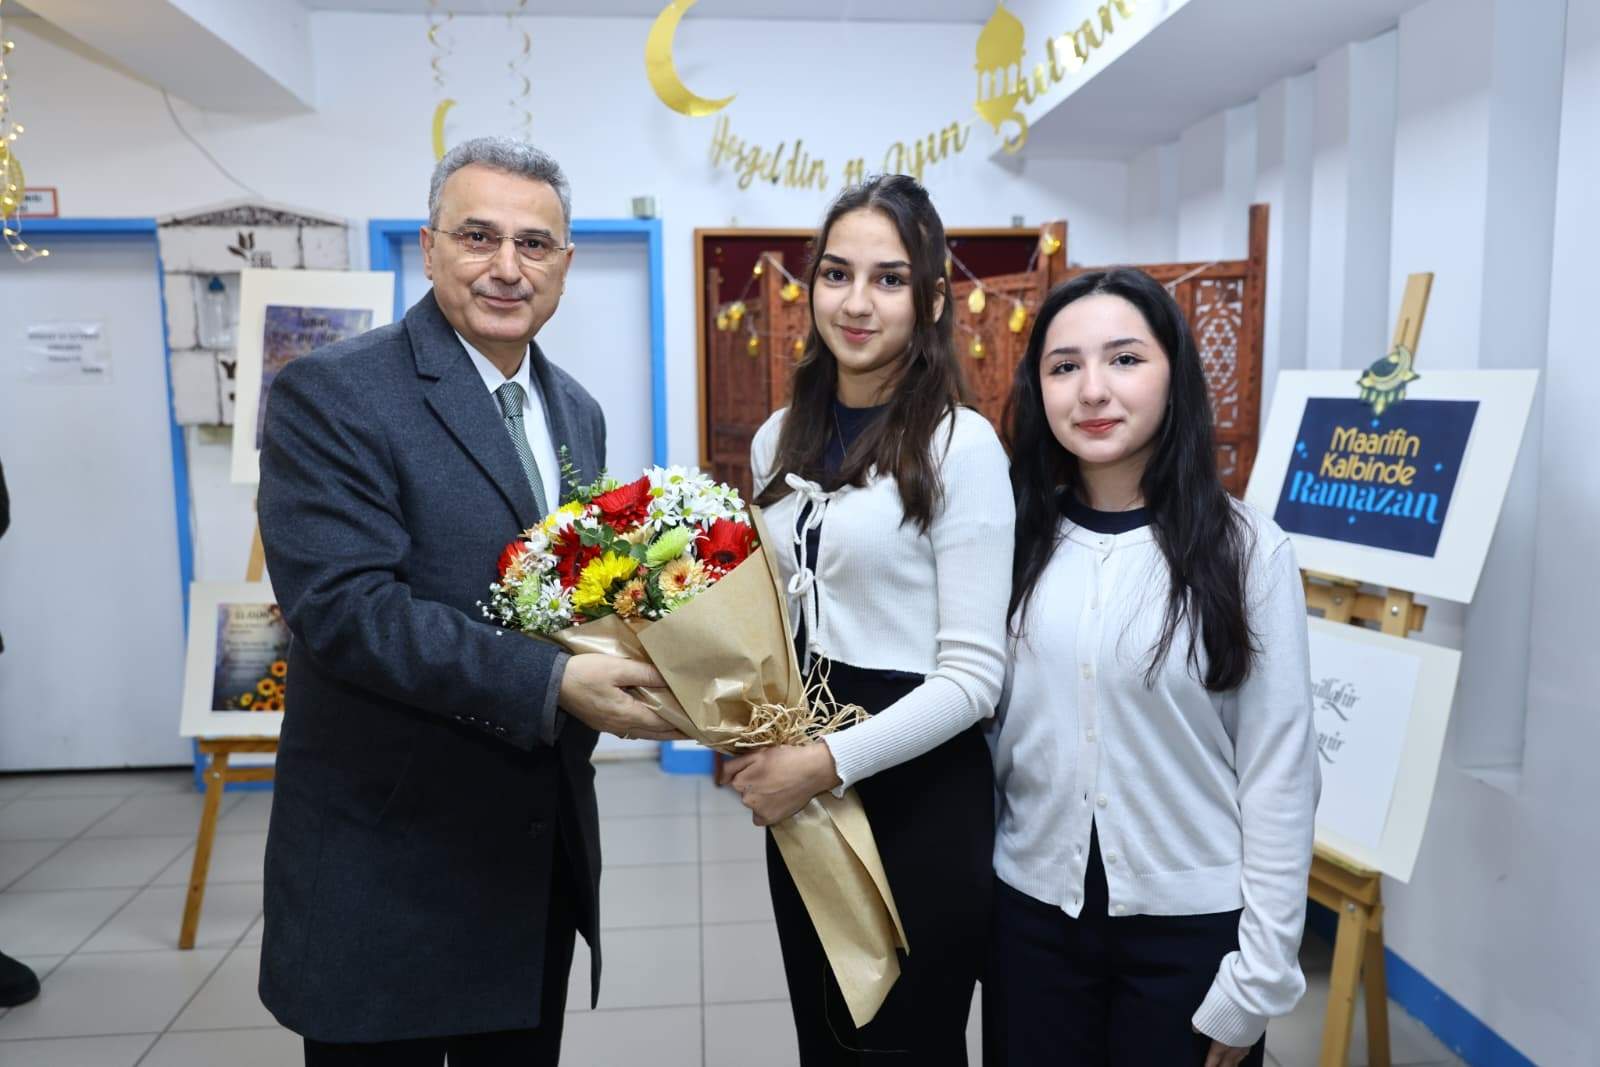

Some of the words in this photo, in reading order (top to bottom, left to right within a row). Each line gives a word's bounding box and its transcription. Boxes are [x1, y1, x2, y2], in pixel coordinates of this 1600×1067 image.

[1329, 425, 1421, 458] Maarifin
[1319, 451, 1417, 486] Kalbinde
[1289, 470, 1441, 524] Ramazan
